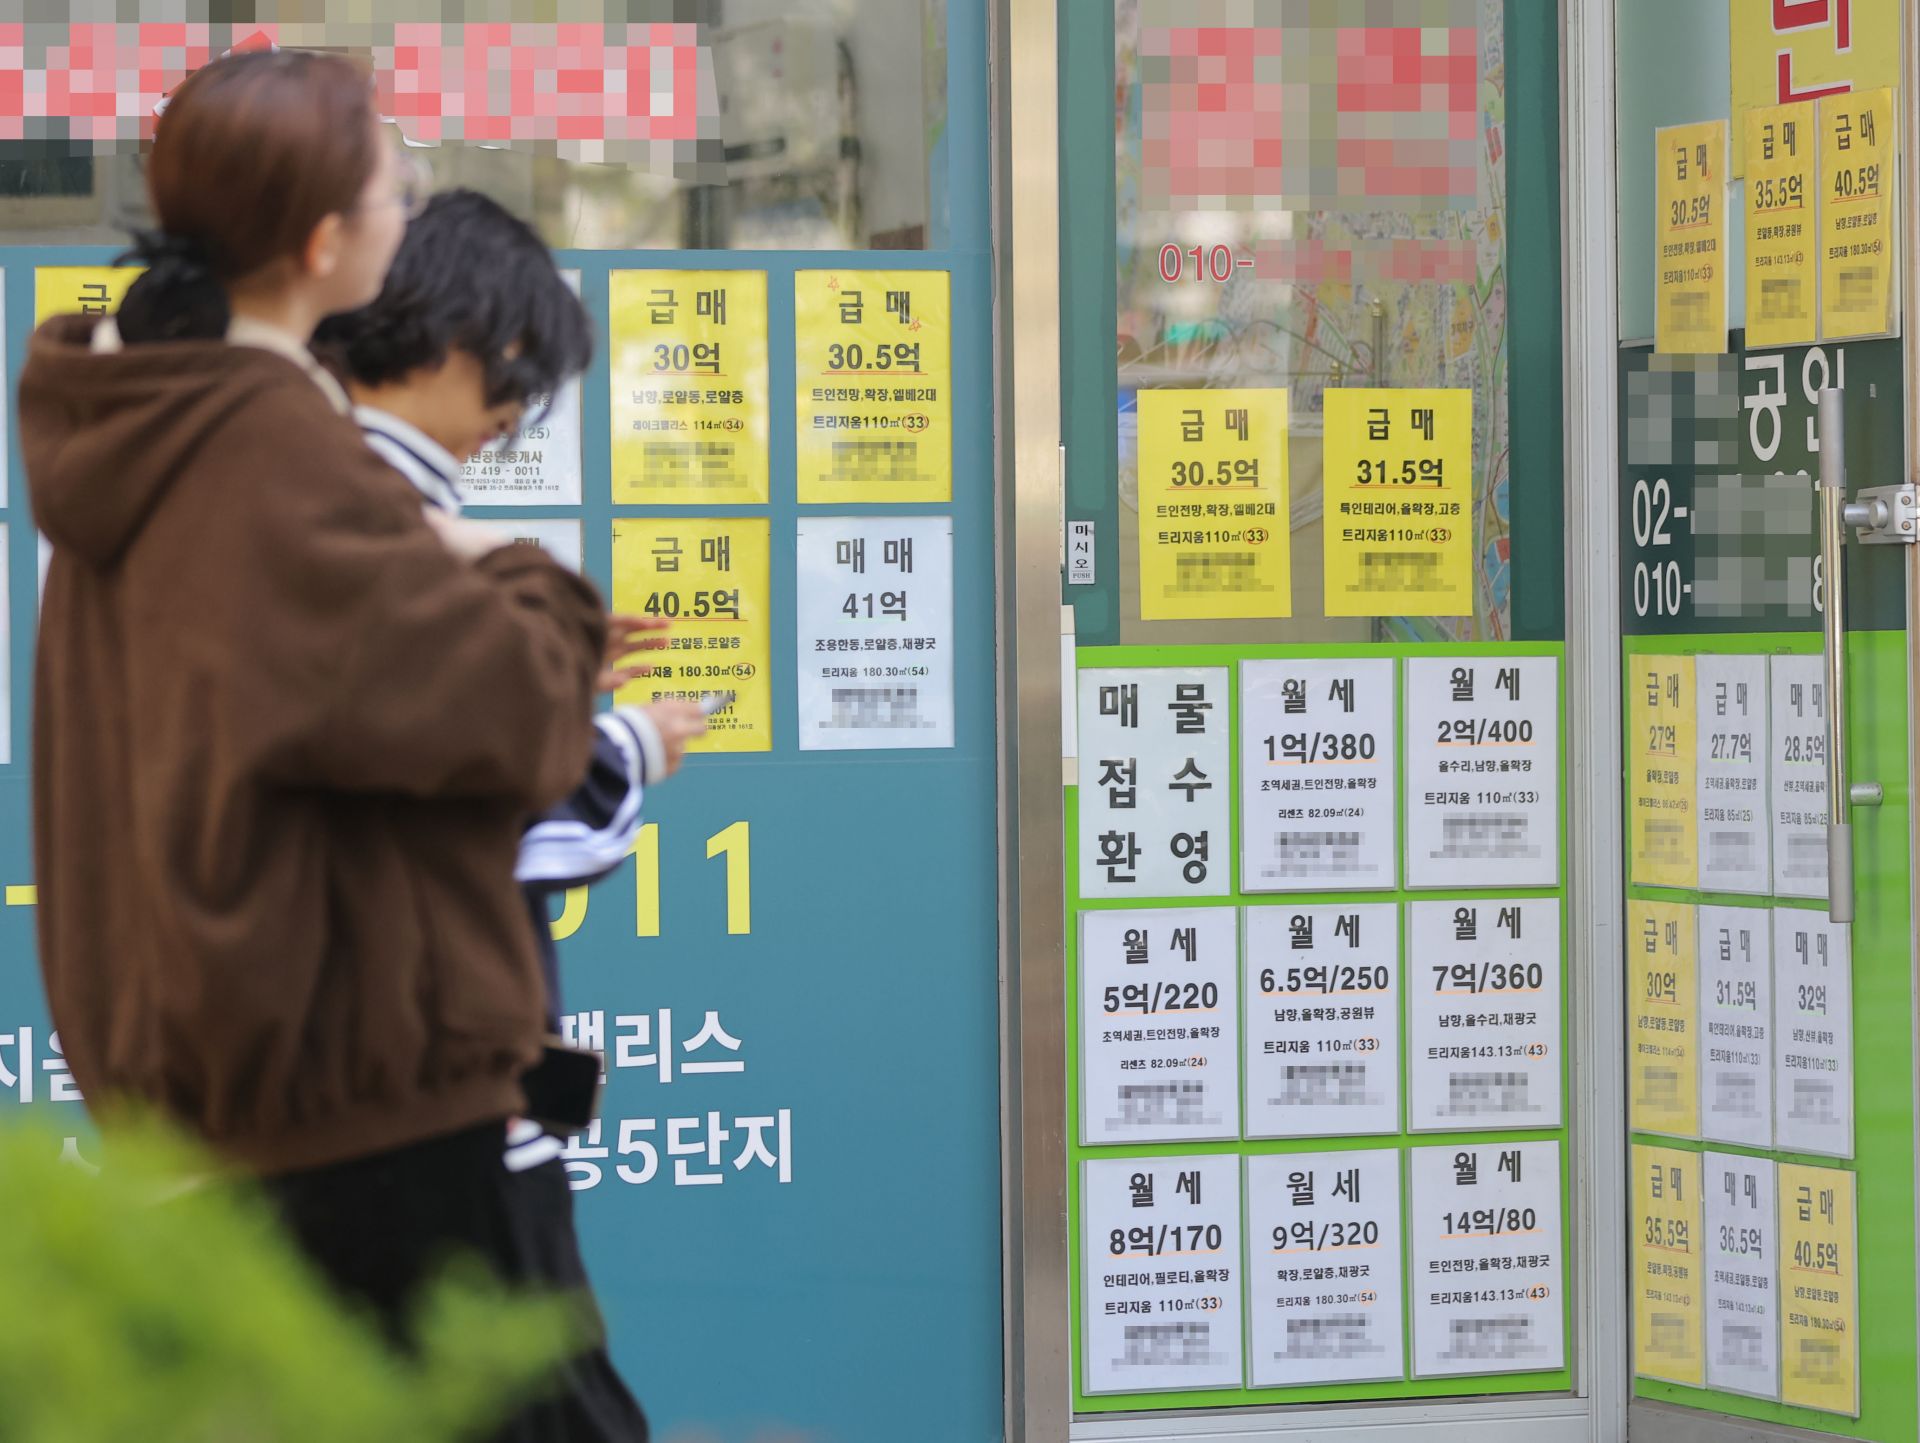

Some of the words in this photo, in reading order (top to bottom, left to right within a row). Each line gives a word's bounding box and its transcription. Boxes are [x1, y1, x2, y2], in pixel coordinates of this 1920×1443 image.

[1755, 173, 1803, 209] 35.5억
[1834, 163, 1880, 197] 40.5억
[1671, 193, 1711, 226] 30.5억
[1156, 242, 1256, 284] 010-
[654, 342, 721, 374] 30억
[828, 342, 921, 373] 30.5억
[480, 466, 502, 476] 419
[514, 465, 541, 476] 0011
[1171, 458, 1259, 488] 30.5억
[1356, 458, 1443, 488] 31.5억
[644, 588, 740, 620] 40.5억
[842, 590, 907, 622] 41억
[1263, 731, 1376, 765] 1억/380
[1437, 718, 1533, 746] 2억/400
[1648, 725, 1676, 756] 27억
[1711, 732, 1752, 764] 27.7억
[1424, 791, 1471, 805] 트리지움
[1260, 964, 1389, 995] 6.5억/250
[1432, 961, 1543, 994] 7억/360
[1646, 971, 1676, 1003] 30억
[1103, 981, 1218, 1015] 5억/220
[1716, 979, 1757, 1012] 31.5억
[1798, 984, 1827, 1016] 32억
[1263, 1040, 1311, 1054] 트리지움
[1272, 1220, 1379, 1252] 9억/320
[1442, 1207, 1536, 1236] 14억/80
[1645, 1215, 1690, 1254] 35.5억
[1109, 1224, 1222, 1257] 8억/170
[1719, 1224, 1763, 1260] 36.5억
[1794, 1240, 1839, 1275] 40.5억
[1104, 1300, 1152, 1316] 트리지움
